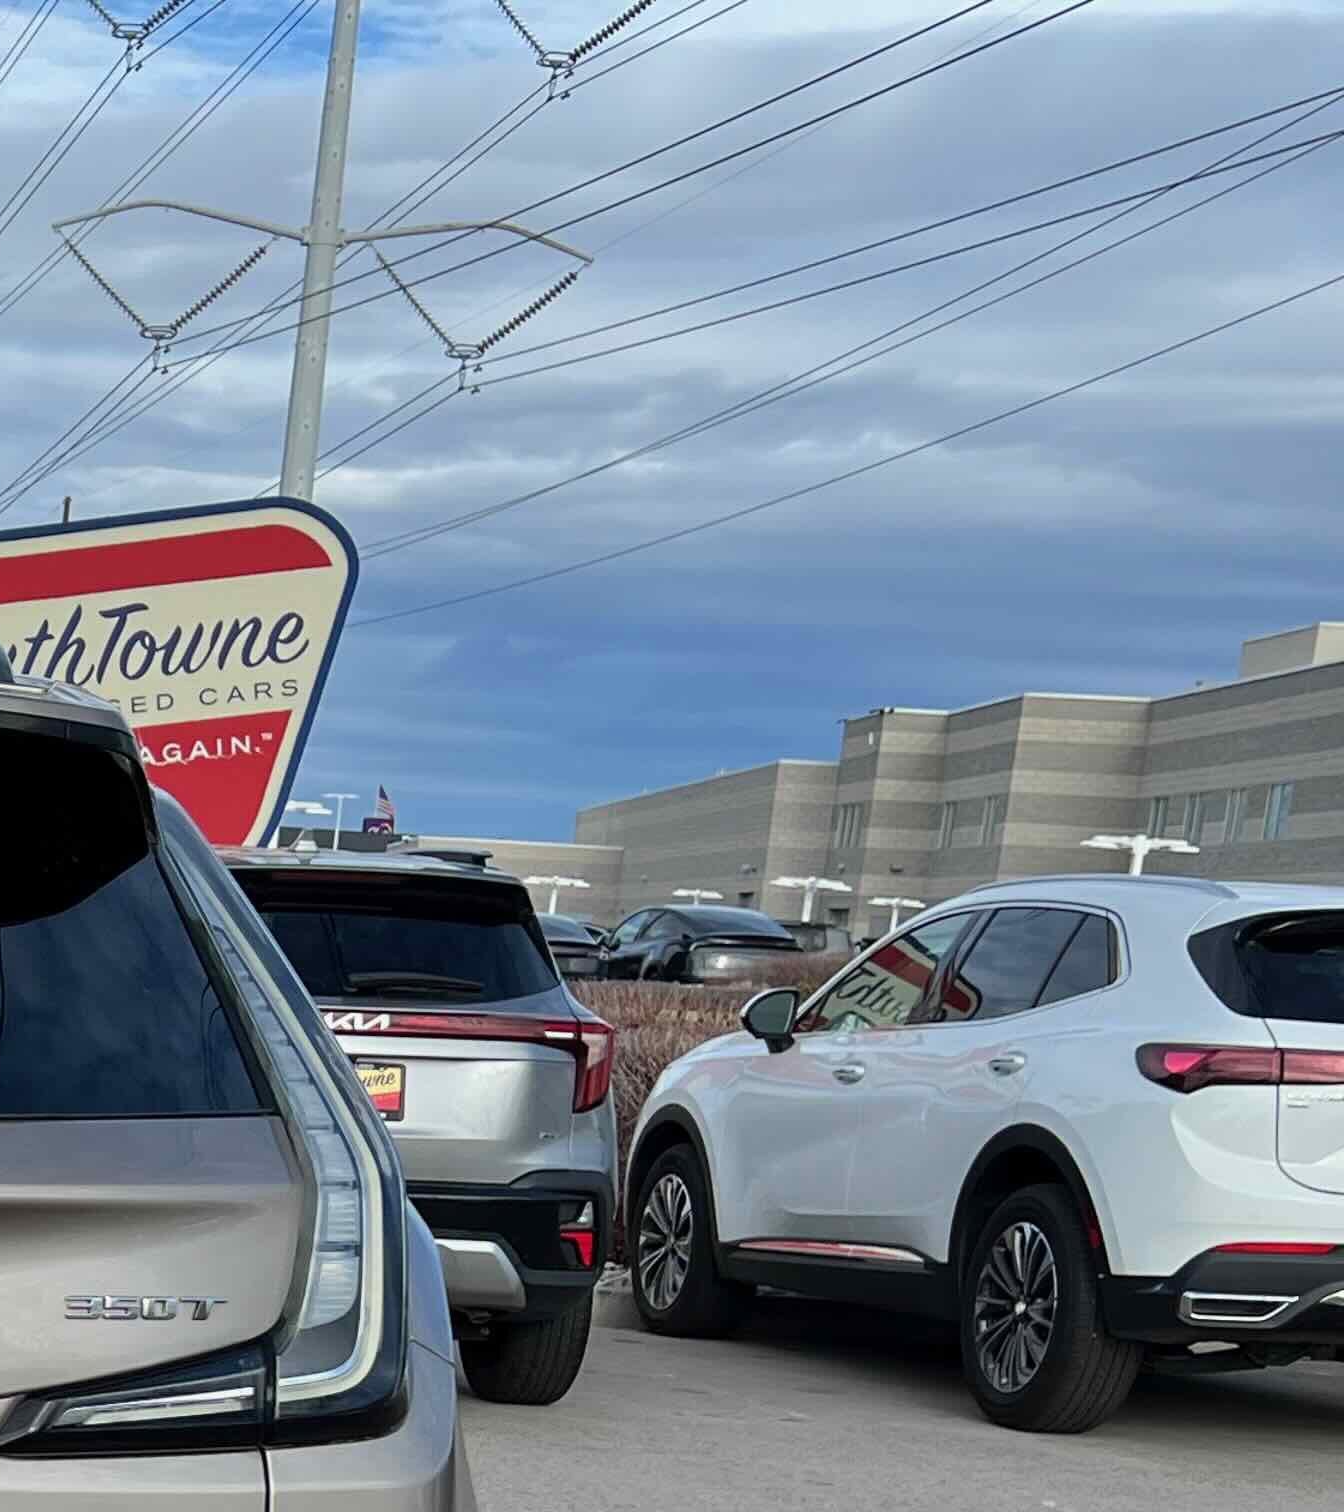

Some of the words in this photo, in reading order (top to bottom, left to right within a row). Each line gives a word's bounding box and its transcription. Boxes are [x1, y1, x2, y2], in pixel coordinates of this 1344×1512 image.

[199, 679, 299, 706] CARS
[323, 1012, 392, 1031] KIA
[64, 1296, 229, 1321] 350T
